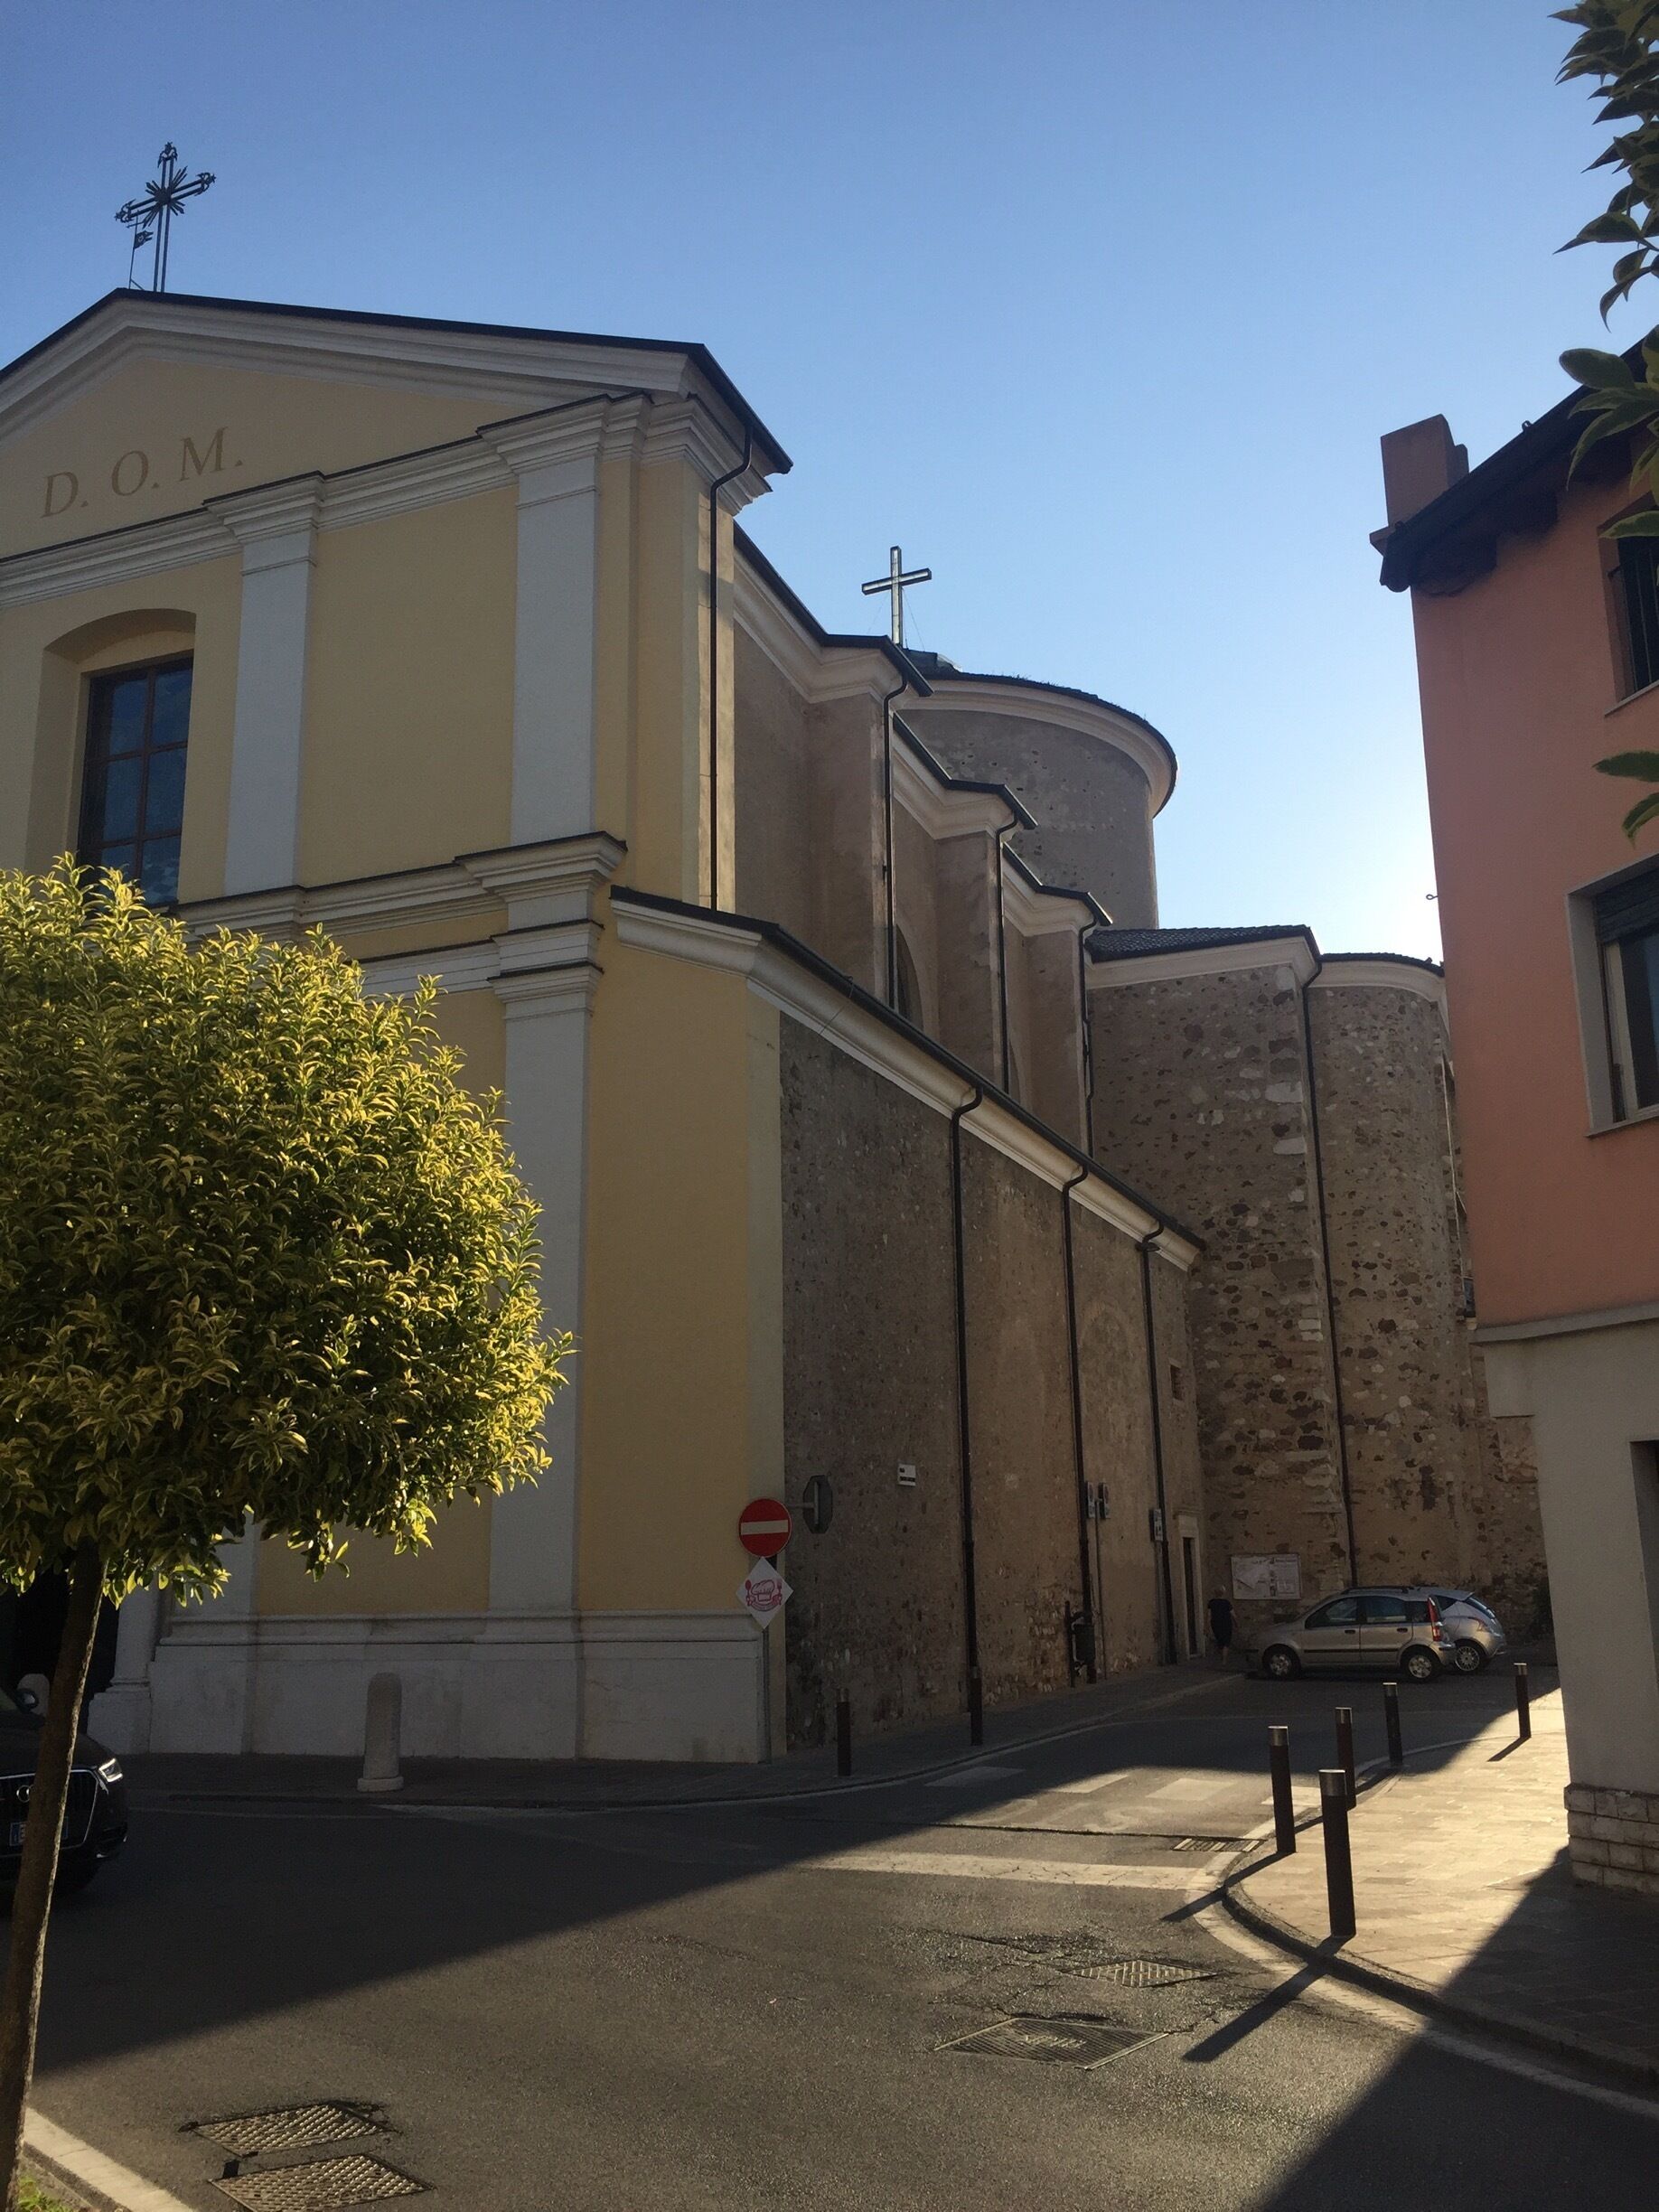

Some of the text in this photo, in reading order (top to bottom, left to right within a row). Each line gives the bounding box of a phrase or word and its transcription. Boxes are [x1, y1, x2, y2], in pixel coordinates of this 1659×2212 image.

[41, 426, 242, 518] D. O. M.
